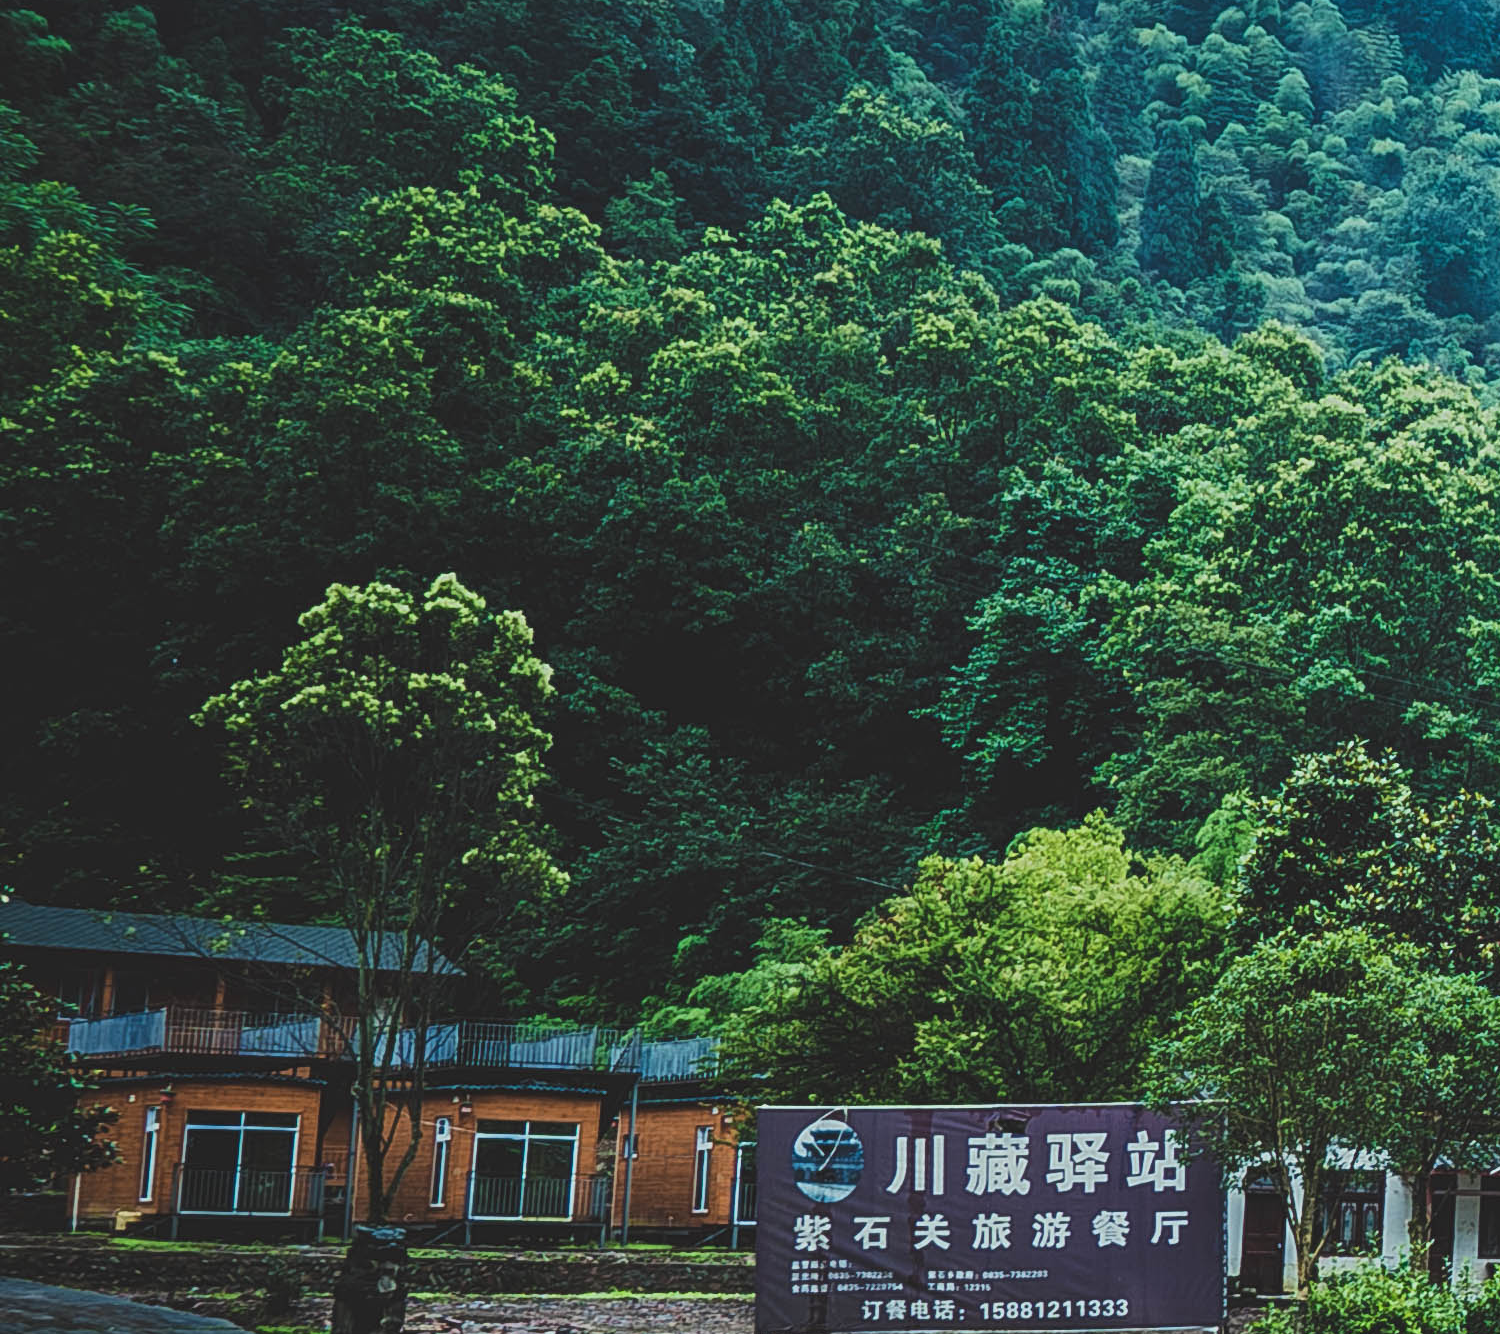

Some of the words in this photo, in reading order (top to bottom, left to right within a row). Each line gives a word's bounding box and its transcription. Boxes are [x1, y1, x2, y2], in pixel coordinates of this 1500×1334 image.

[886, 1129, 1188, 1196] 川藏驿站
[793, 1210, 1189, 1251] 紫石关旅游餐厅
